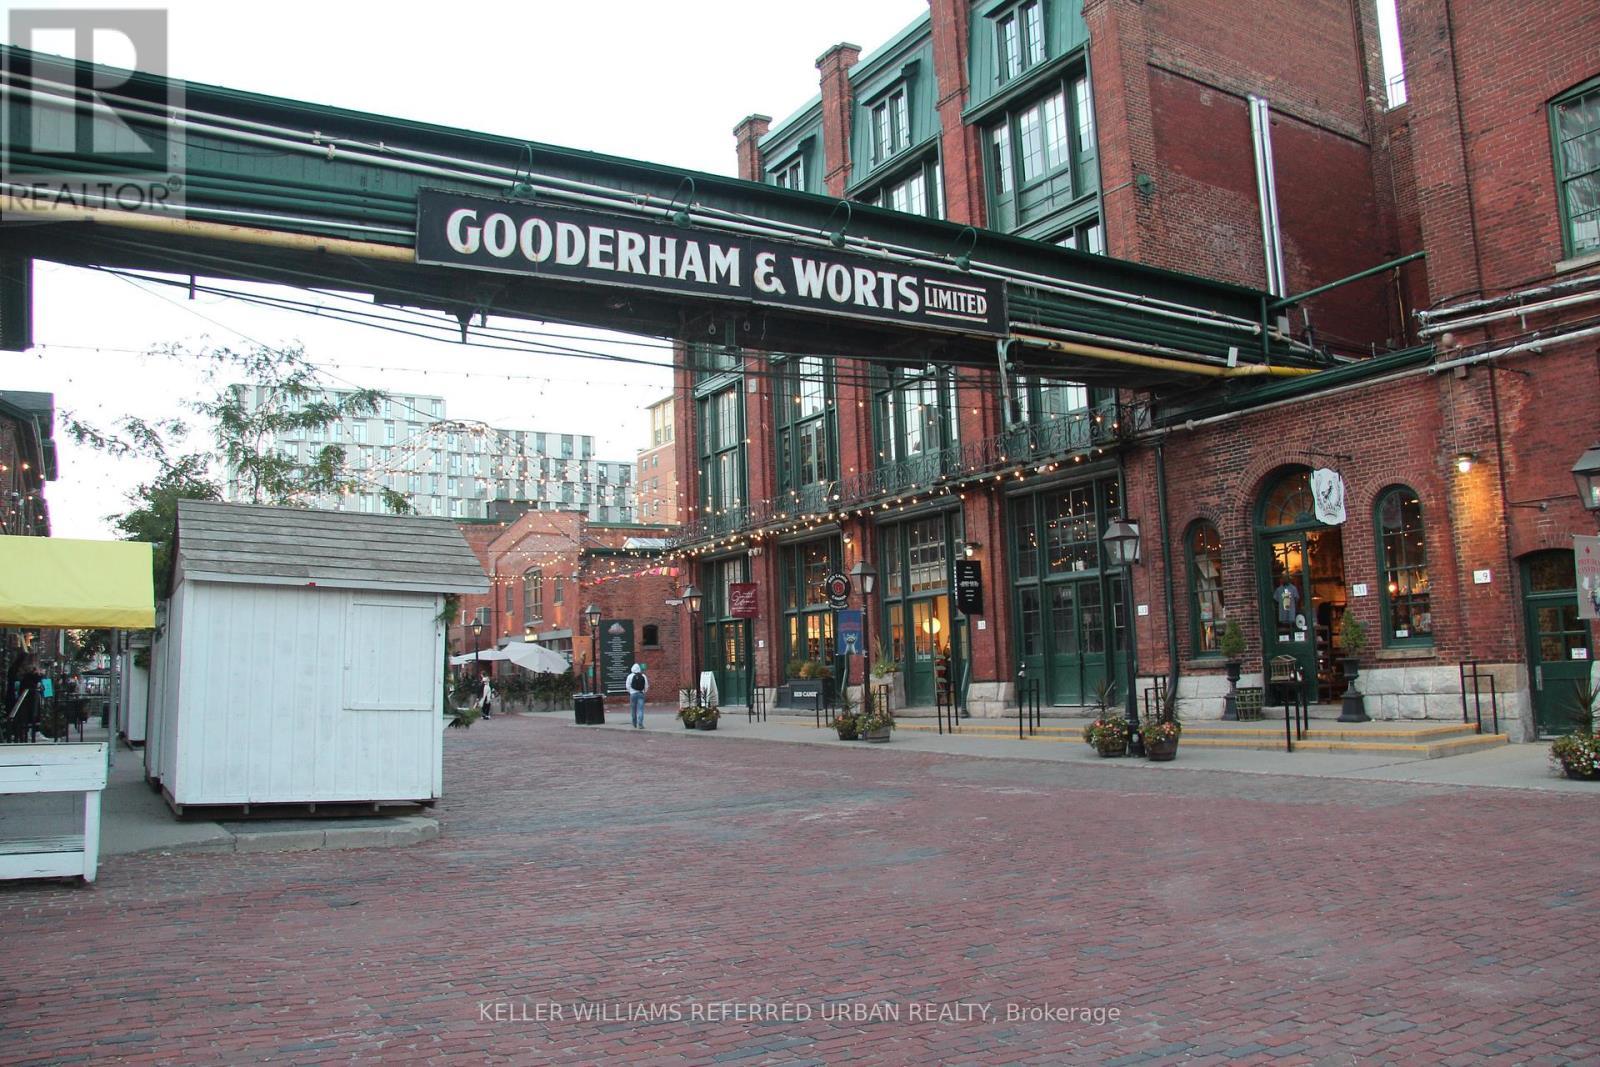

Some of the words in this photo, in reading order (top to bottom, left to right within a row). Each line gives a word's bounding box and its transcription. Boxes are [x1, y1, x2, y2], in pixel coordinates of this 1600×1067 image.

[446, 208, 741, 288] GOODERHAM
[753, 252, 787, 295] &
[791, 256, 920, 314] WORTS
[925, 285, 988, 317] LIMITED
